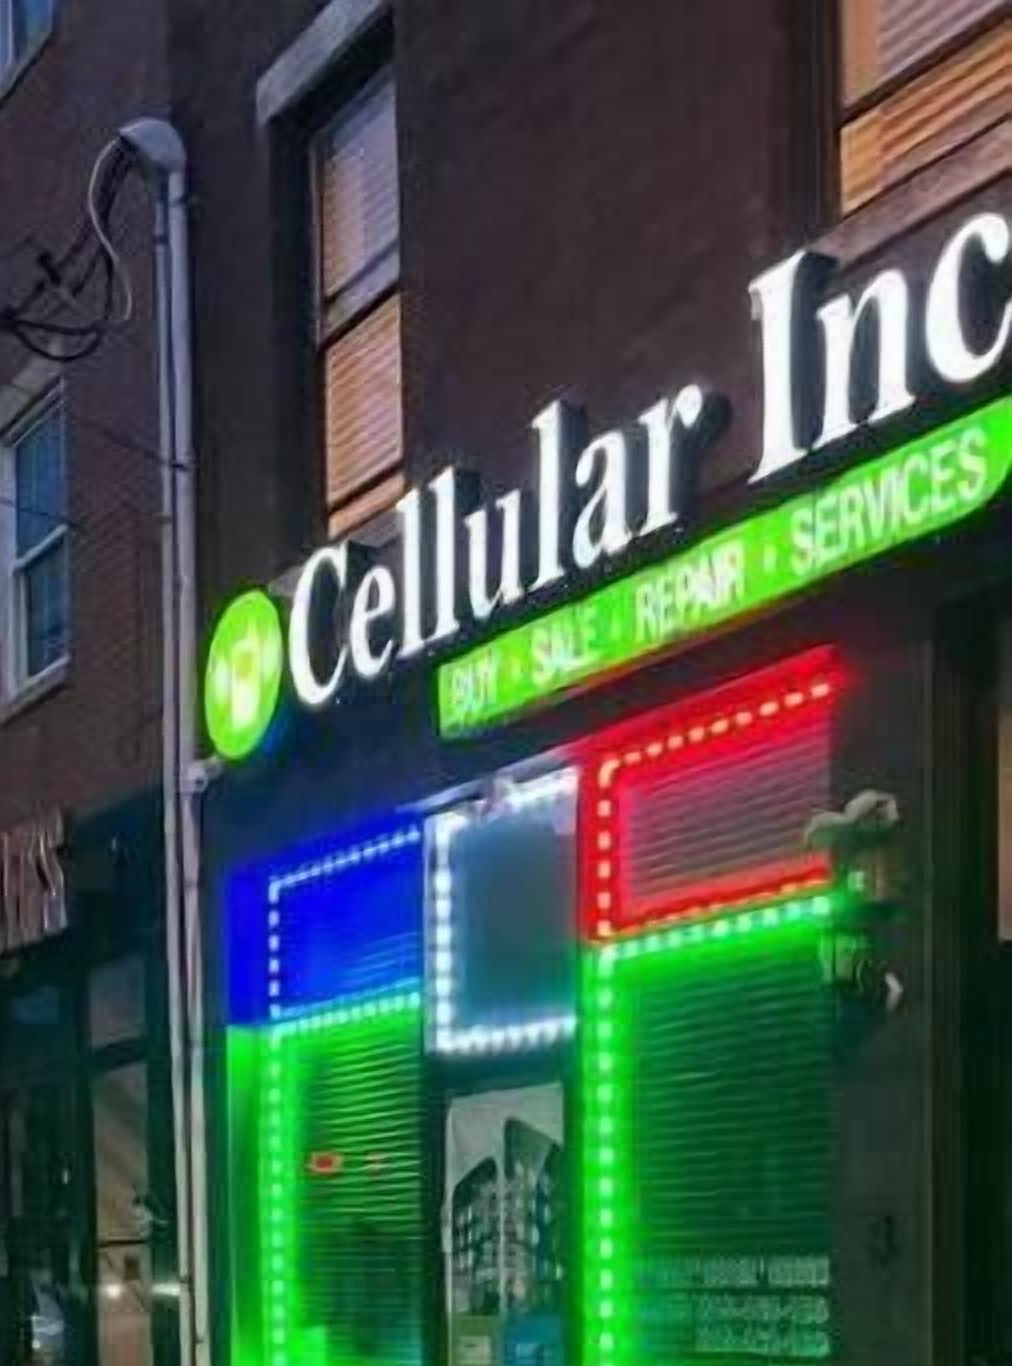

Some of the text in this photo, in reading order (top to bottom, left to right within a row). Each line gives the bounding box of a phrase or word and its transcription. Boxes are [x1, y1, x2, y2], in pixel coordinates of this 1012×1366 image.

[288, 211, 1012, 708] Cellular Inc
[531, 603, 601, 686] SALE
[635, 543, 745, 645] REPAIR
[790, 427, 991, 578] SERVICES
